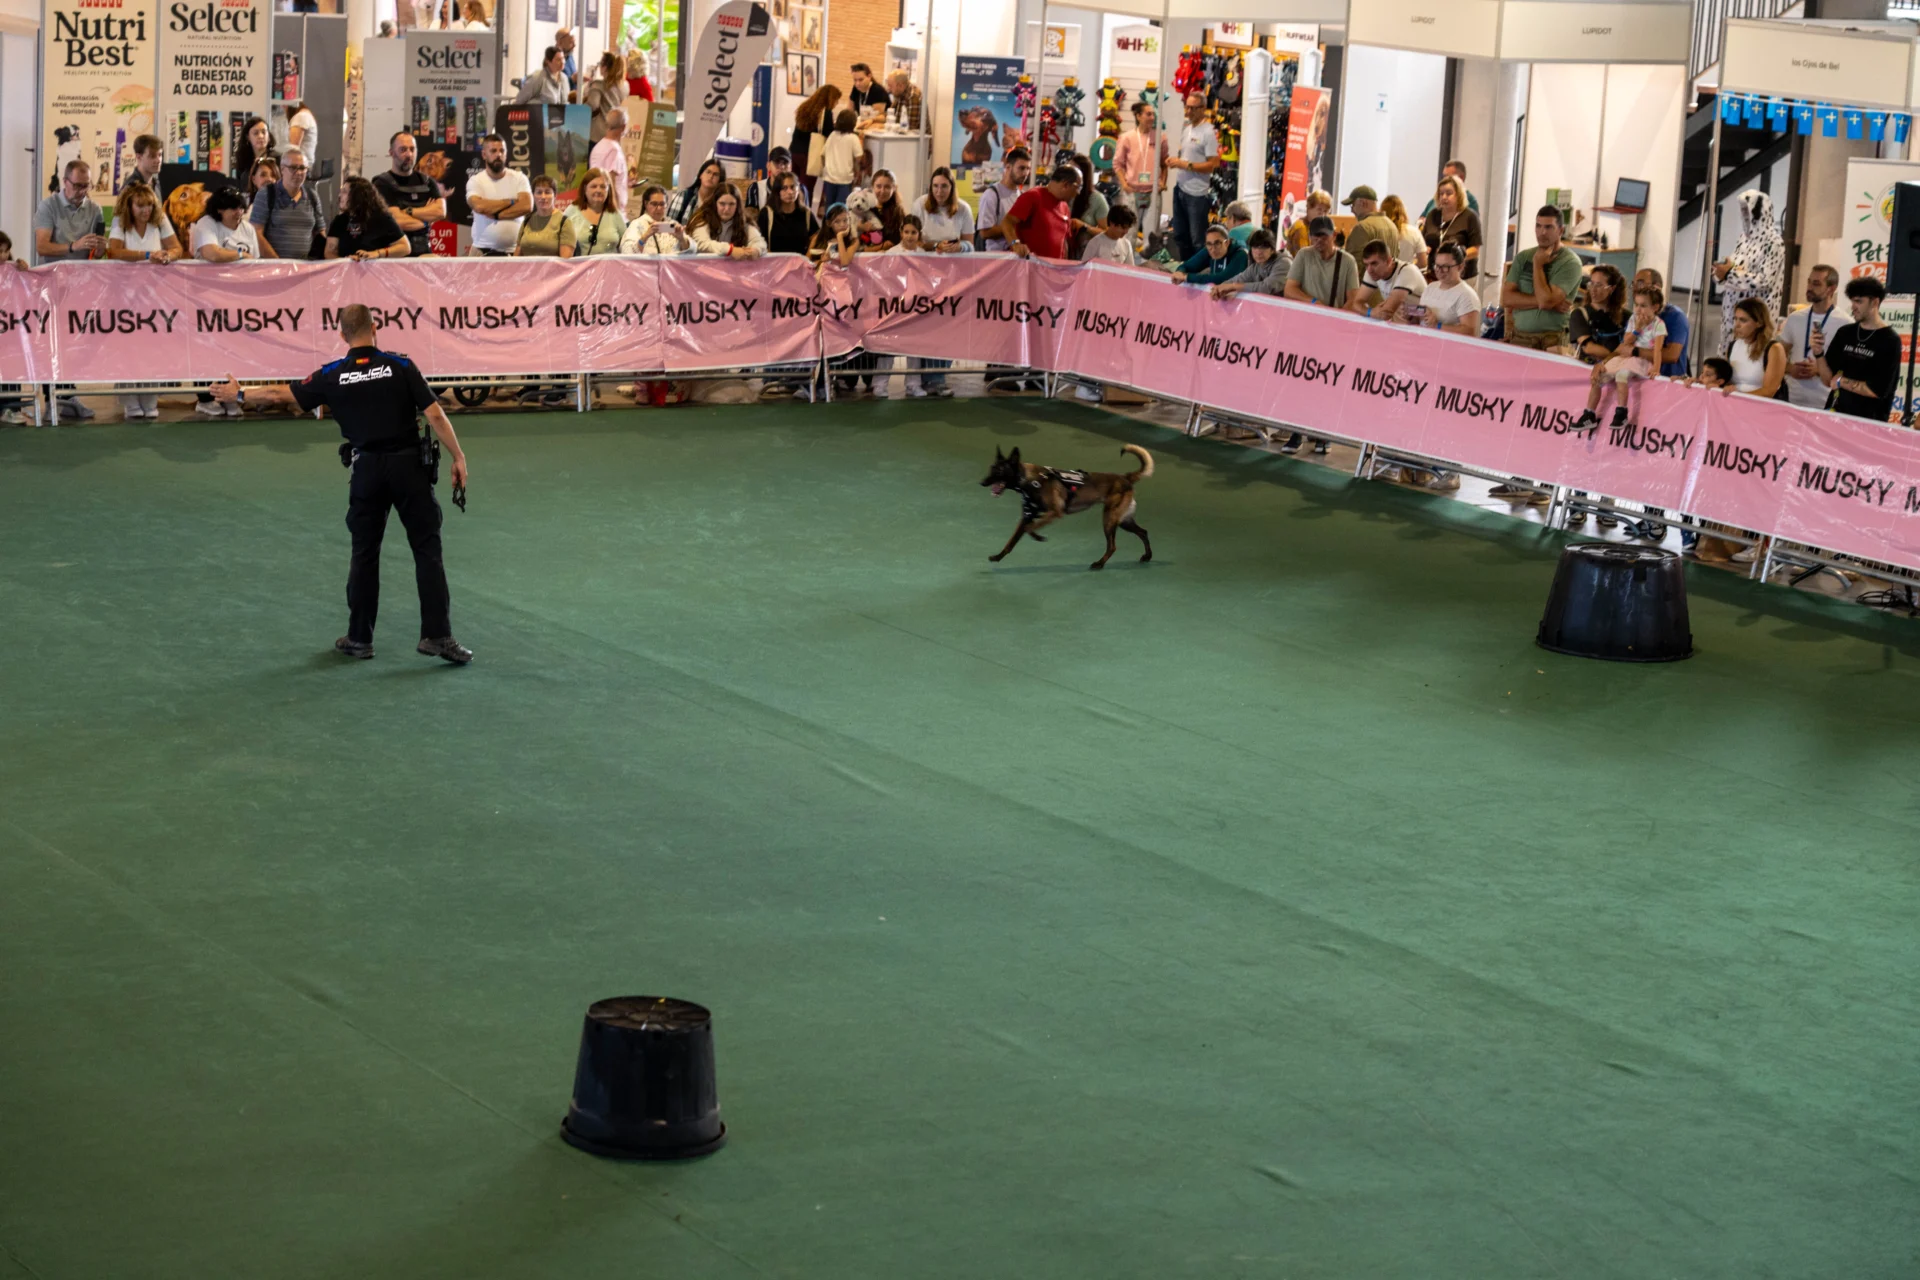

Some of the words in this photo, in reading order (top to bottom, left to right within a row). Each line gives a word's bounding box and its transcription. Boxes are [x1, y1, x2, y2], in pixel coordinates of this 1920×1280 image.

[53, 10, 147, 42] Nutri
[169, 2, 259, 33] Select
[1582, 27, 1612, 35] LUPIDOT
[64, 39, 134, 67] Best
[174, 53, 242, 67] NUTRICIÓN
[245, 55, 254, 67] Y
[417, 44, 483, 69] Select
[1818, 60, 1828, 69] de
[181, 69, 246, 81] BIENESTAR
[704, 27, 740, 113] Select
[173, 83, 182, 95] A
[185, 84, 217, 96] CADA
[221, 84, 254, 96] PASO
[1852, 239, 1884, 264] Pet
[69, 309, 179, 334] MUSKY
[196, 308, 304, 333] MUSKY
[439, 305, 540, 330] MUSKY
[555, 303, 648, 328] MUSKY
[665, 298, 758, 325] MUSKY
[878, 295, 963, 319] MUSKY
[976, 297, 1064, 329] MUSKY
[1135, 321, 1195, 353] MUSKY
[1198, 335, 1268, 370] MUSKY
[1274, 351, 1345, 387] MUSKY
[1352, 367, 1428, 404] MUSKY
[1435, 385, 1514, 423] MUSKY
[1609, 422, 1694, 461] MUSKY
[1703, 440, 1788, 482] MUSKY
[1797, 461, 1894, 506] MUSKY
